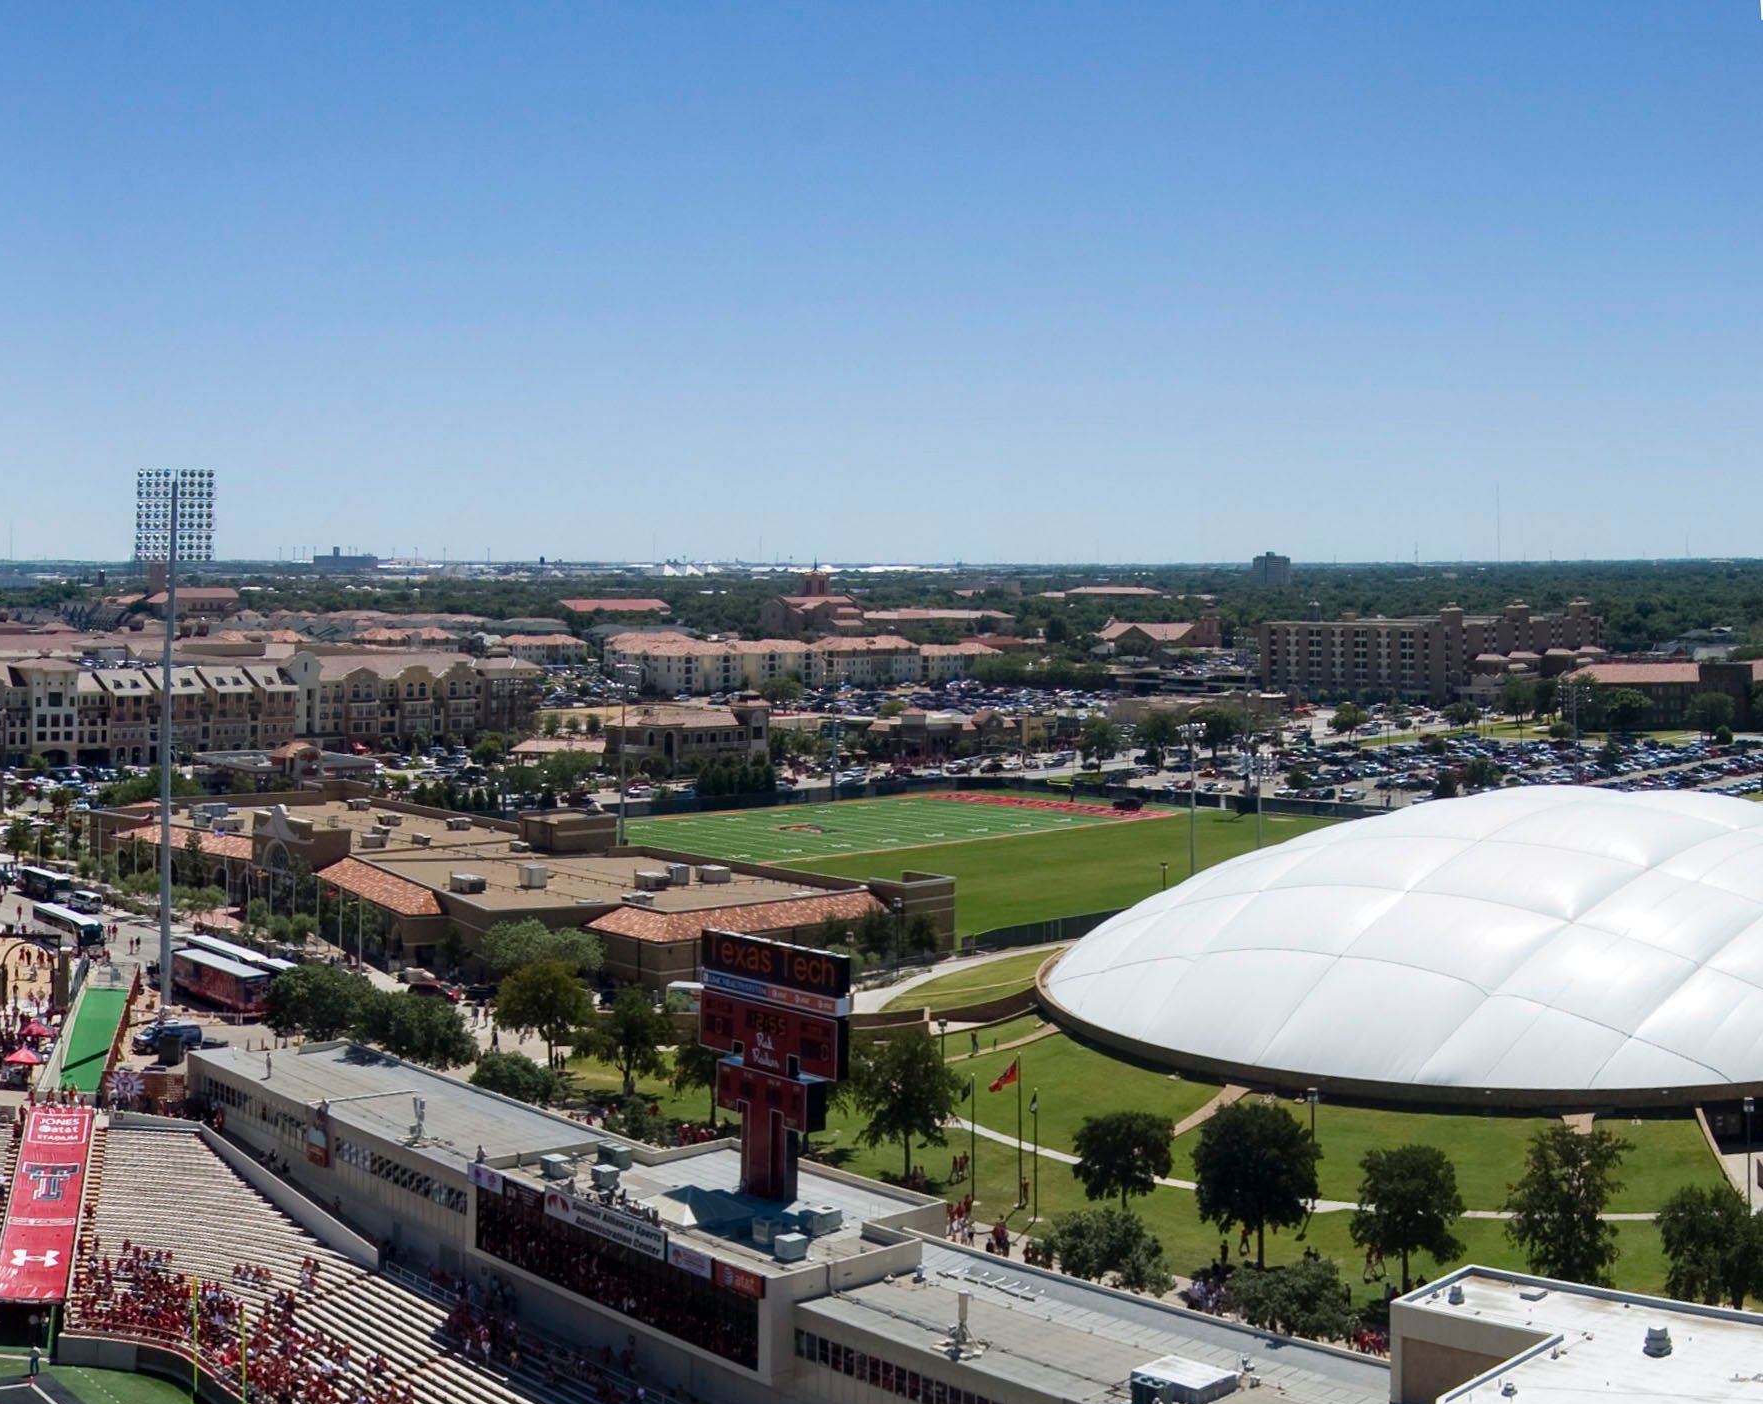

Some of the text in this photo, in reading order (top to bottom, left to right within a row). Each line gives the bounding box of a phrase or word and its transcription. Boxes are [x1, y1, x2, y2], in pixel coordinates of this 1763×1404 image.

[710, 935, 836, 987] Texas Tech
[39, 1117, 80, 1126] JONES
[635, 1225, 663, 1242] Sports
[633, 1238, 661, 1256] Center
